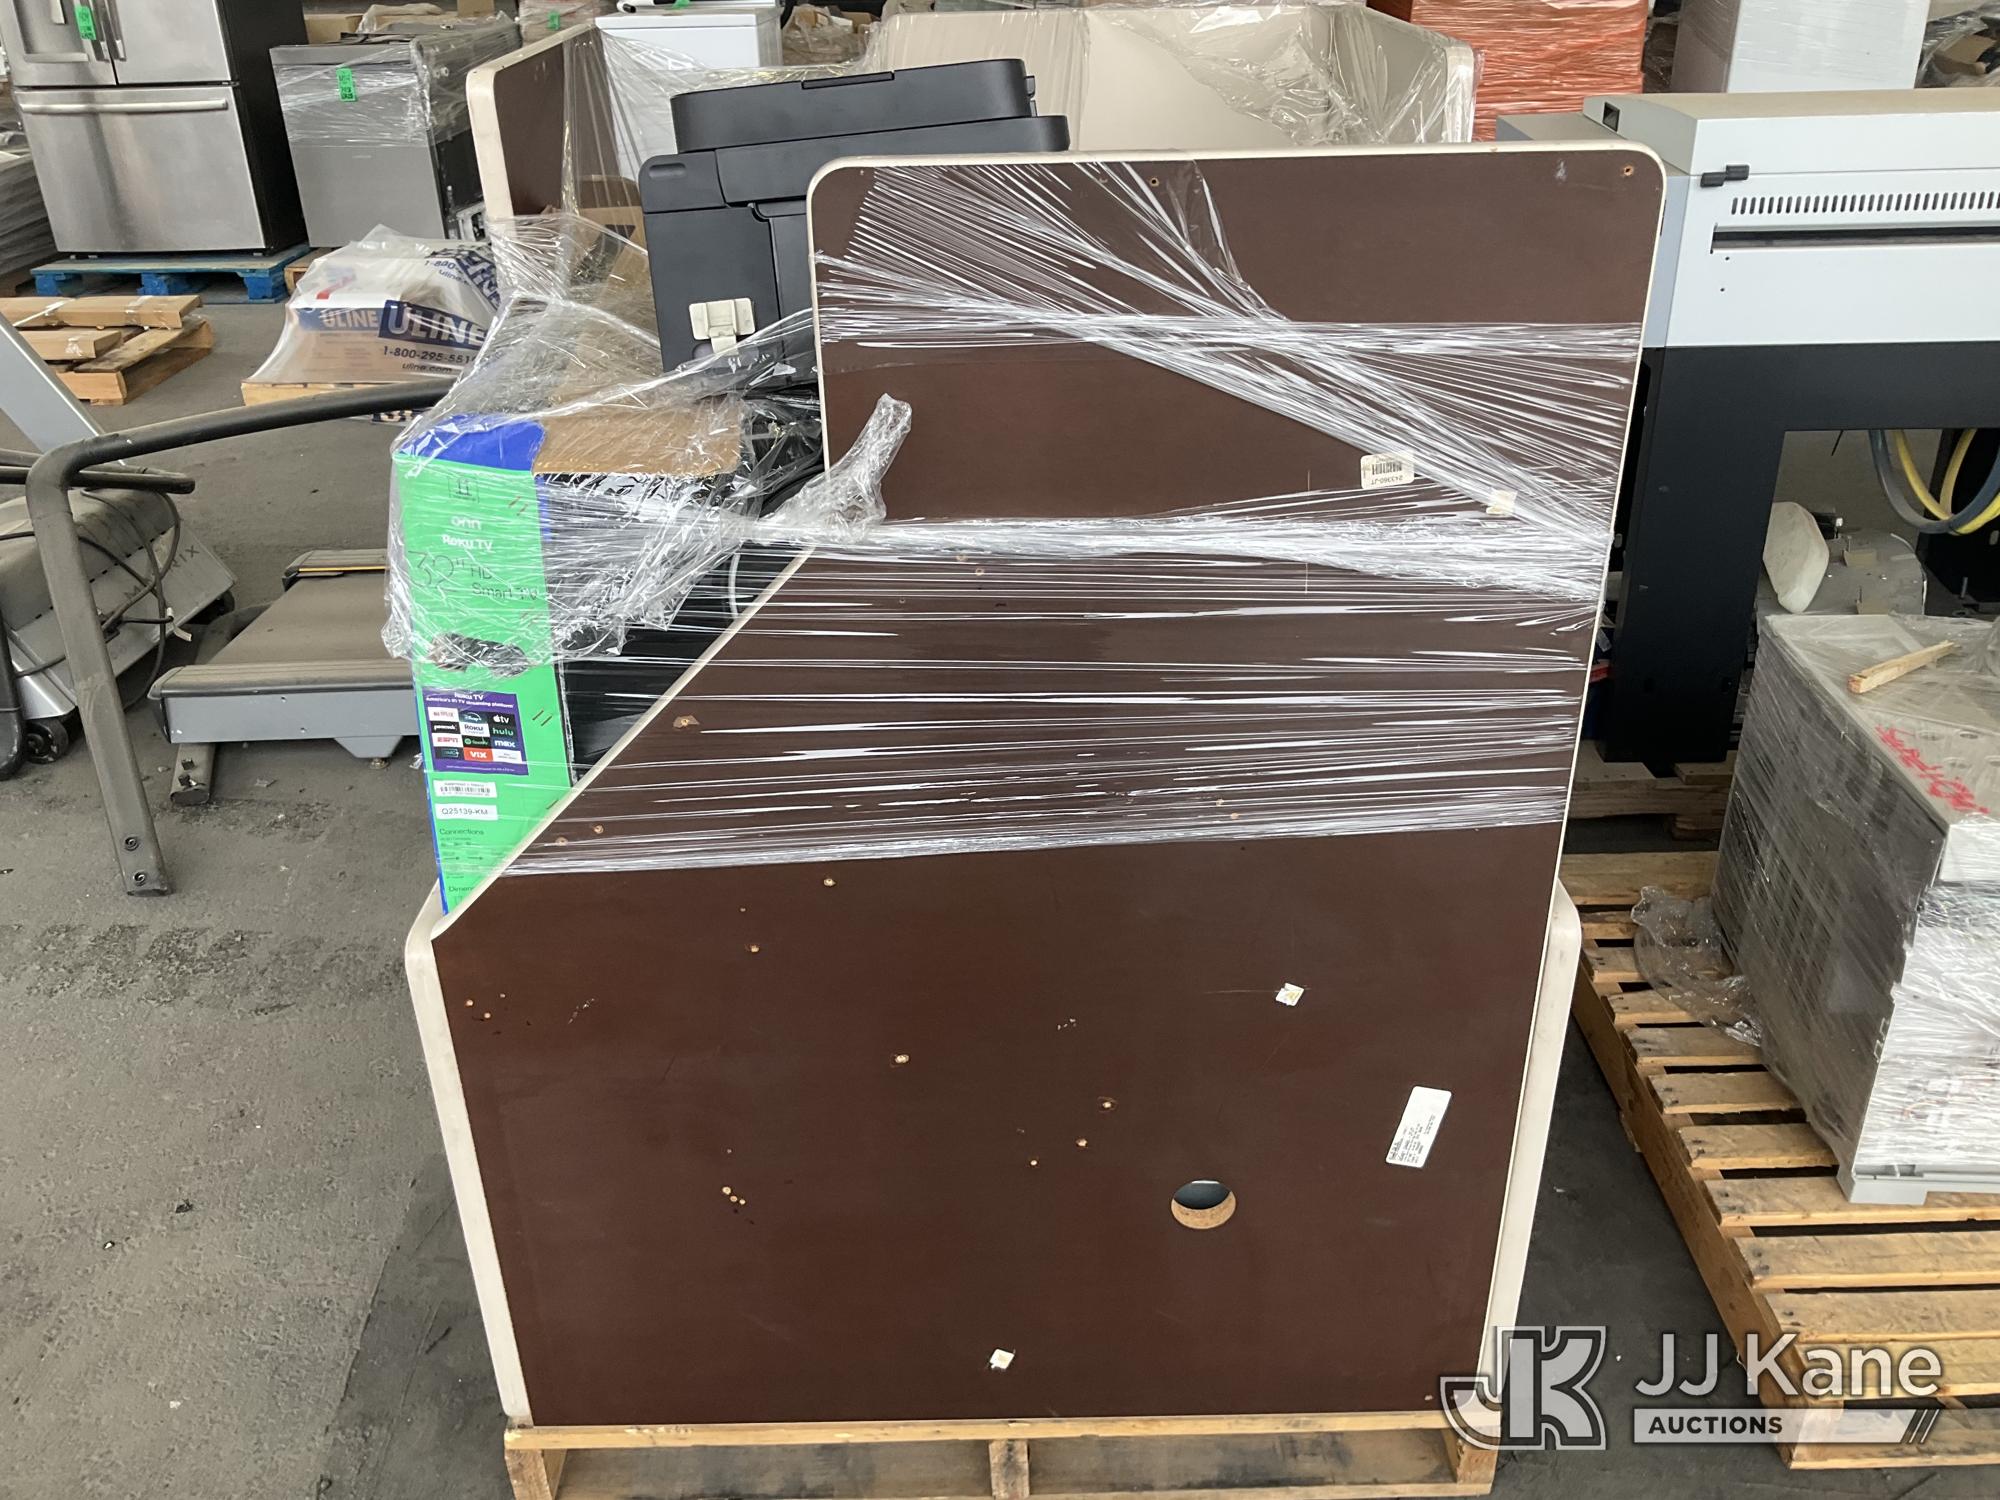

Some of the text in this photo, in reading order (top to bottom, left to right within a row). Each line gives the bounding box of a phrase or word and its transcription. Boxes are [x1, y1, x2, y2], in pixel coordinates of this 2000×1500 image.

[323, 310, 379, 328] ULINE
[389, 304, 486, 346] ULINE
[402, 363, 453, 374] uline.com
[476, 539, 494, 553] TV
[471, 563, 493, 580] HD
[472, 582, 513, 599] Smart
[492, 727, 514, 736] hulu
[494, 739, 516, 748] max
[441, 807, 489, 816] Q25139-KM
[439, 828, 484, 836] Connections
